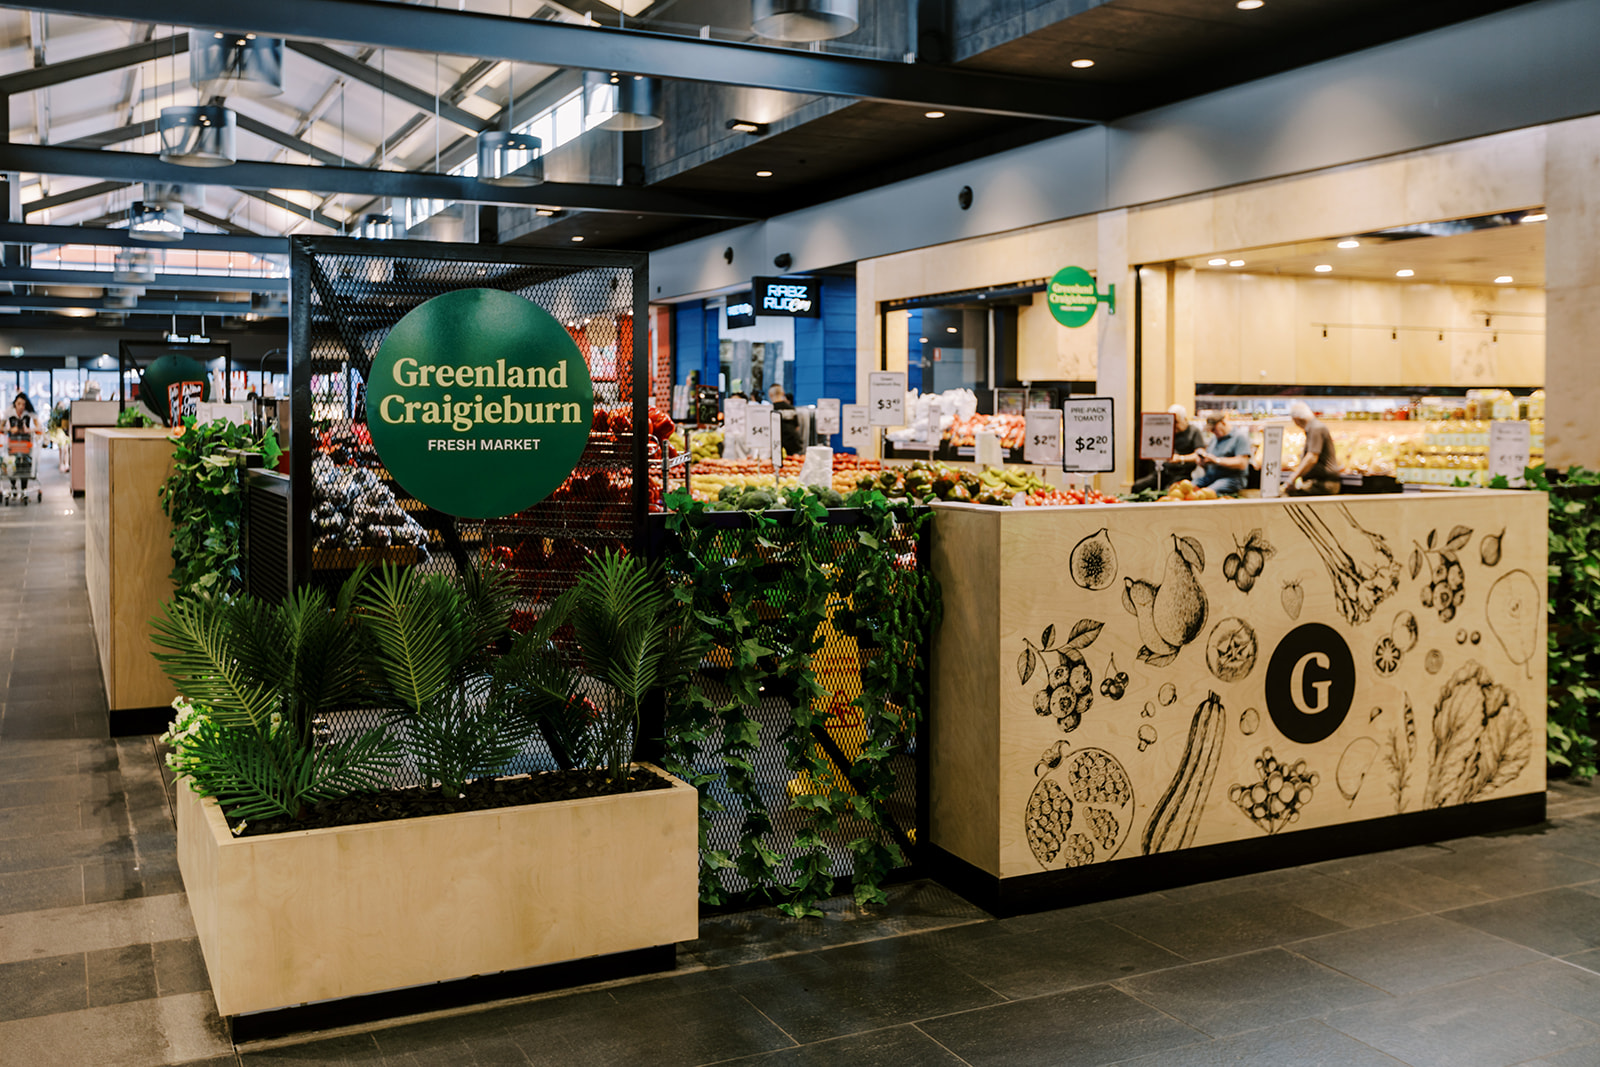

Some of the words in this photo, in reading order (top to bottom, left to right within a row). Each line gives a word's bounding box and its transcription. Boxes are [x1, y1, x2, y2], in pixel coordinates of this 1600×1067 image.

[767, 284, 808, 298] RABZ
[392, 357, 568, 388] Greenland
[379, 394, 582, 432] Craigieburn
[428, 439, 476, 450] FRESH
[480, 438, 541, 450] MARKET
[1290, 651, 1332, 714] G
